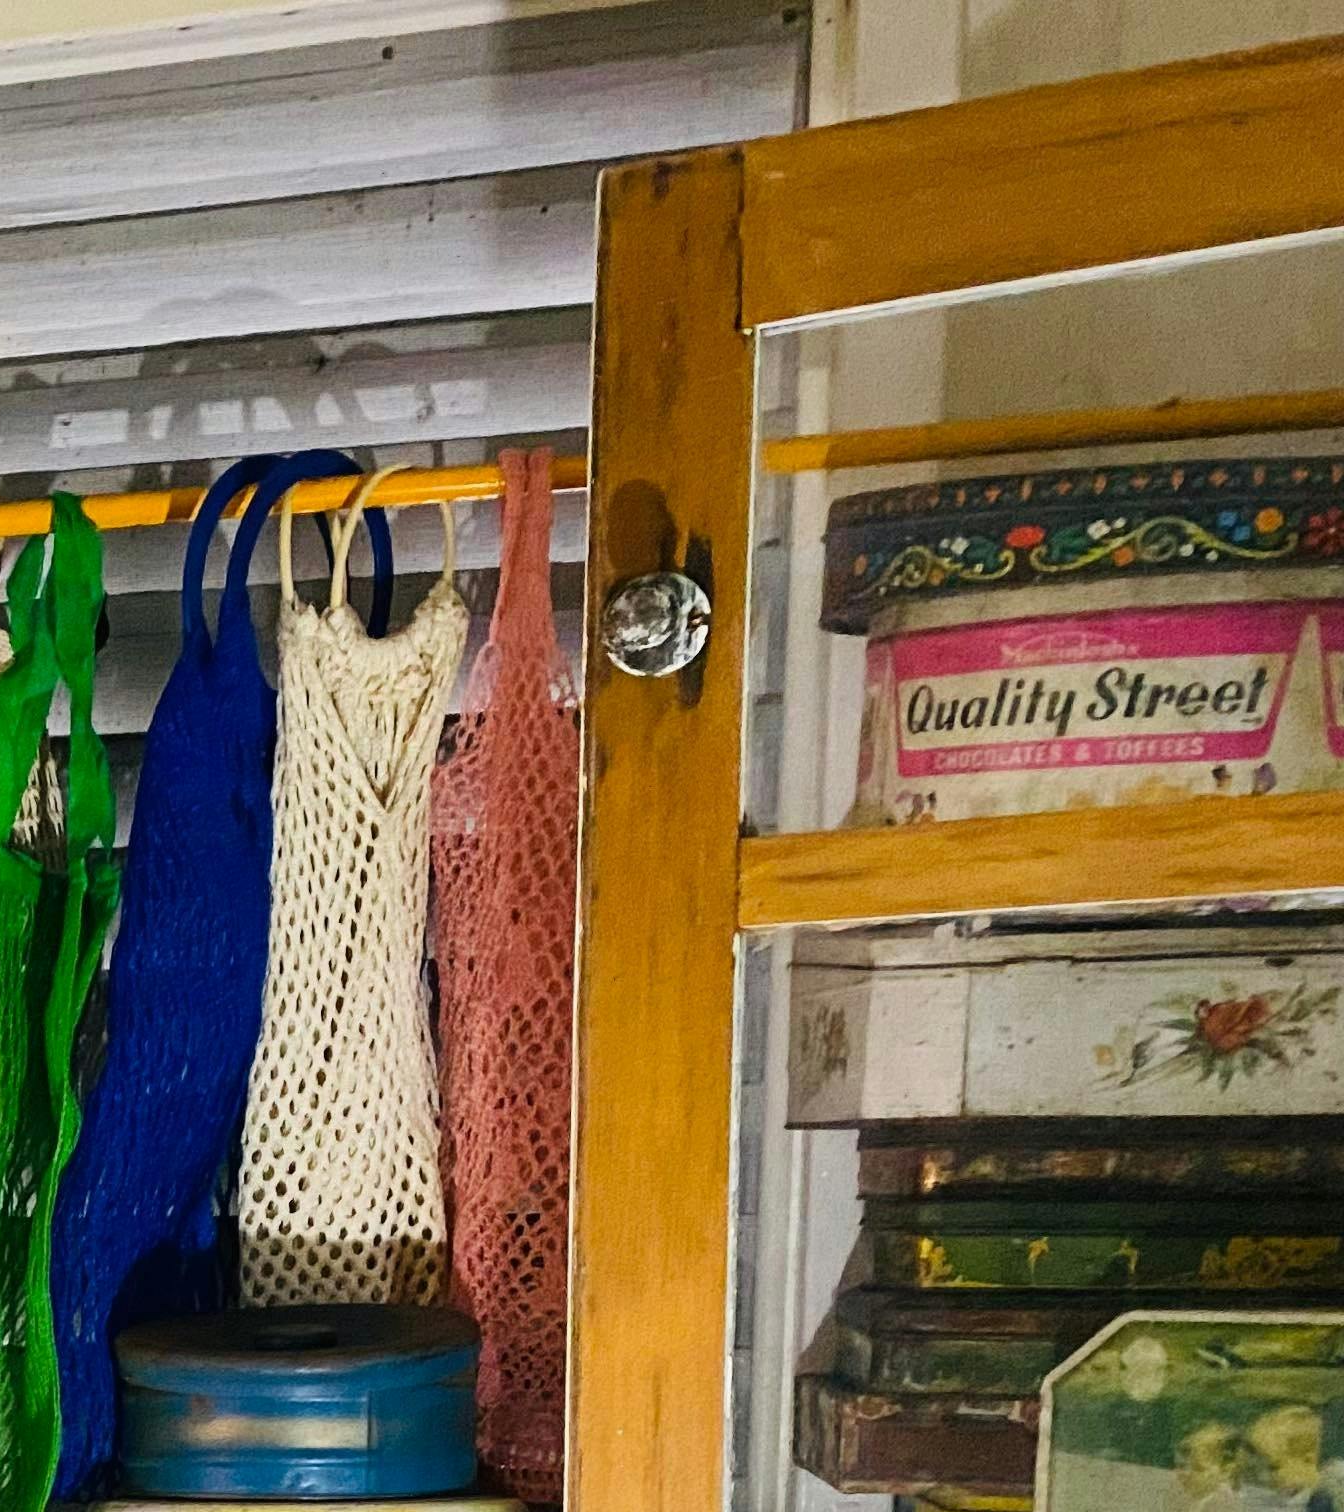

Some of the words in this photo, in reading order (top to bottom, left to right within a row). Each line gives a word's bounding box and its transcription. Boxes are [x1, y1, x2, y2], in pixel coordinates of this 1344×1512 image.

[906, 678, 1077, 738] Quality
[1086, 666, 1270, 724] Street
[933, 745, 1061, 772] CHOCOLATES
[1104, 737, 1205, 761] TOFFEES
